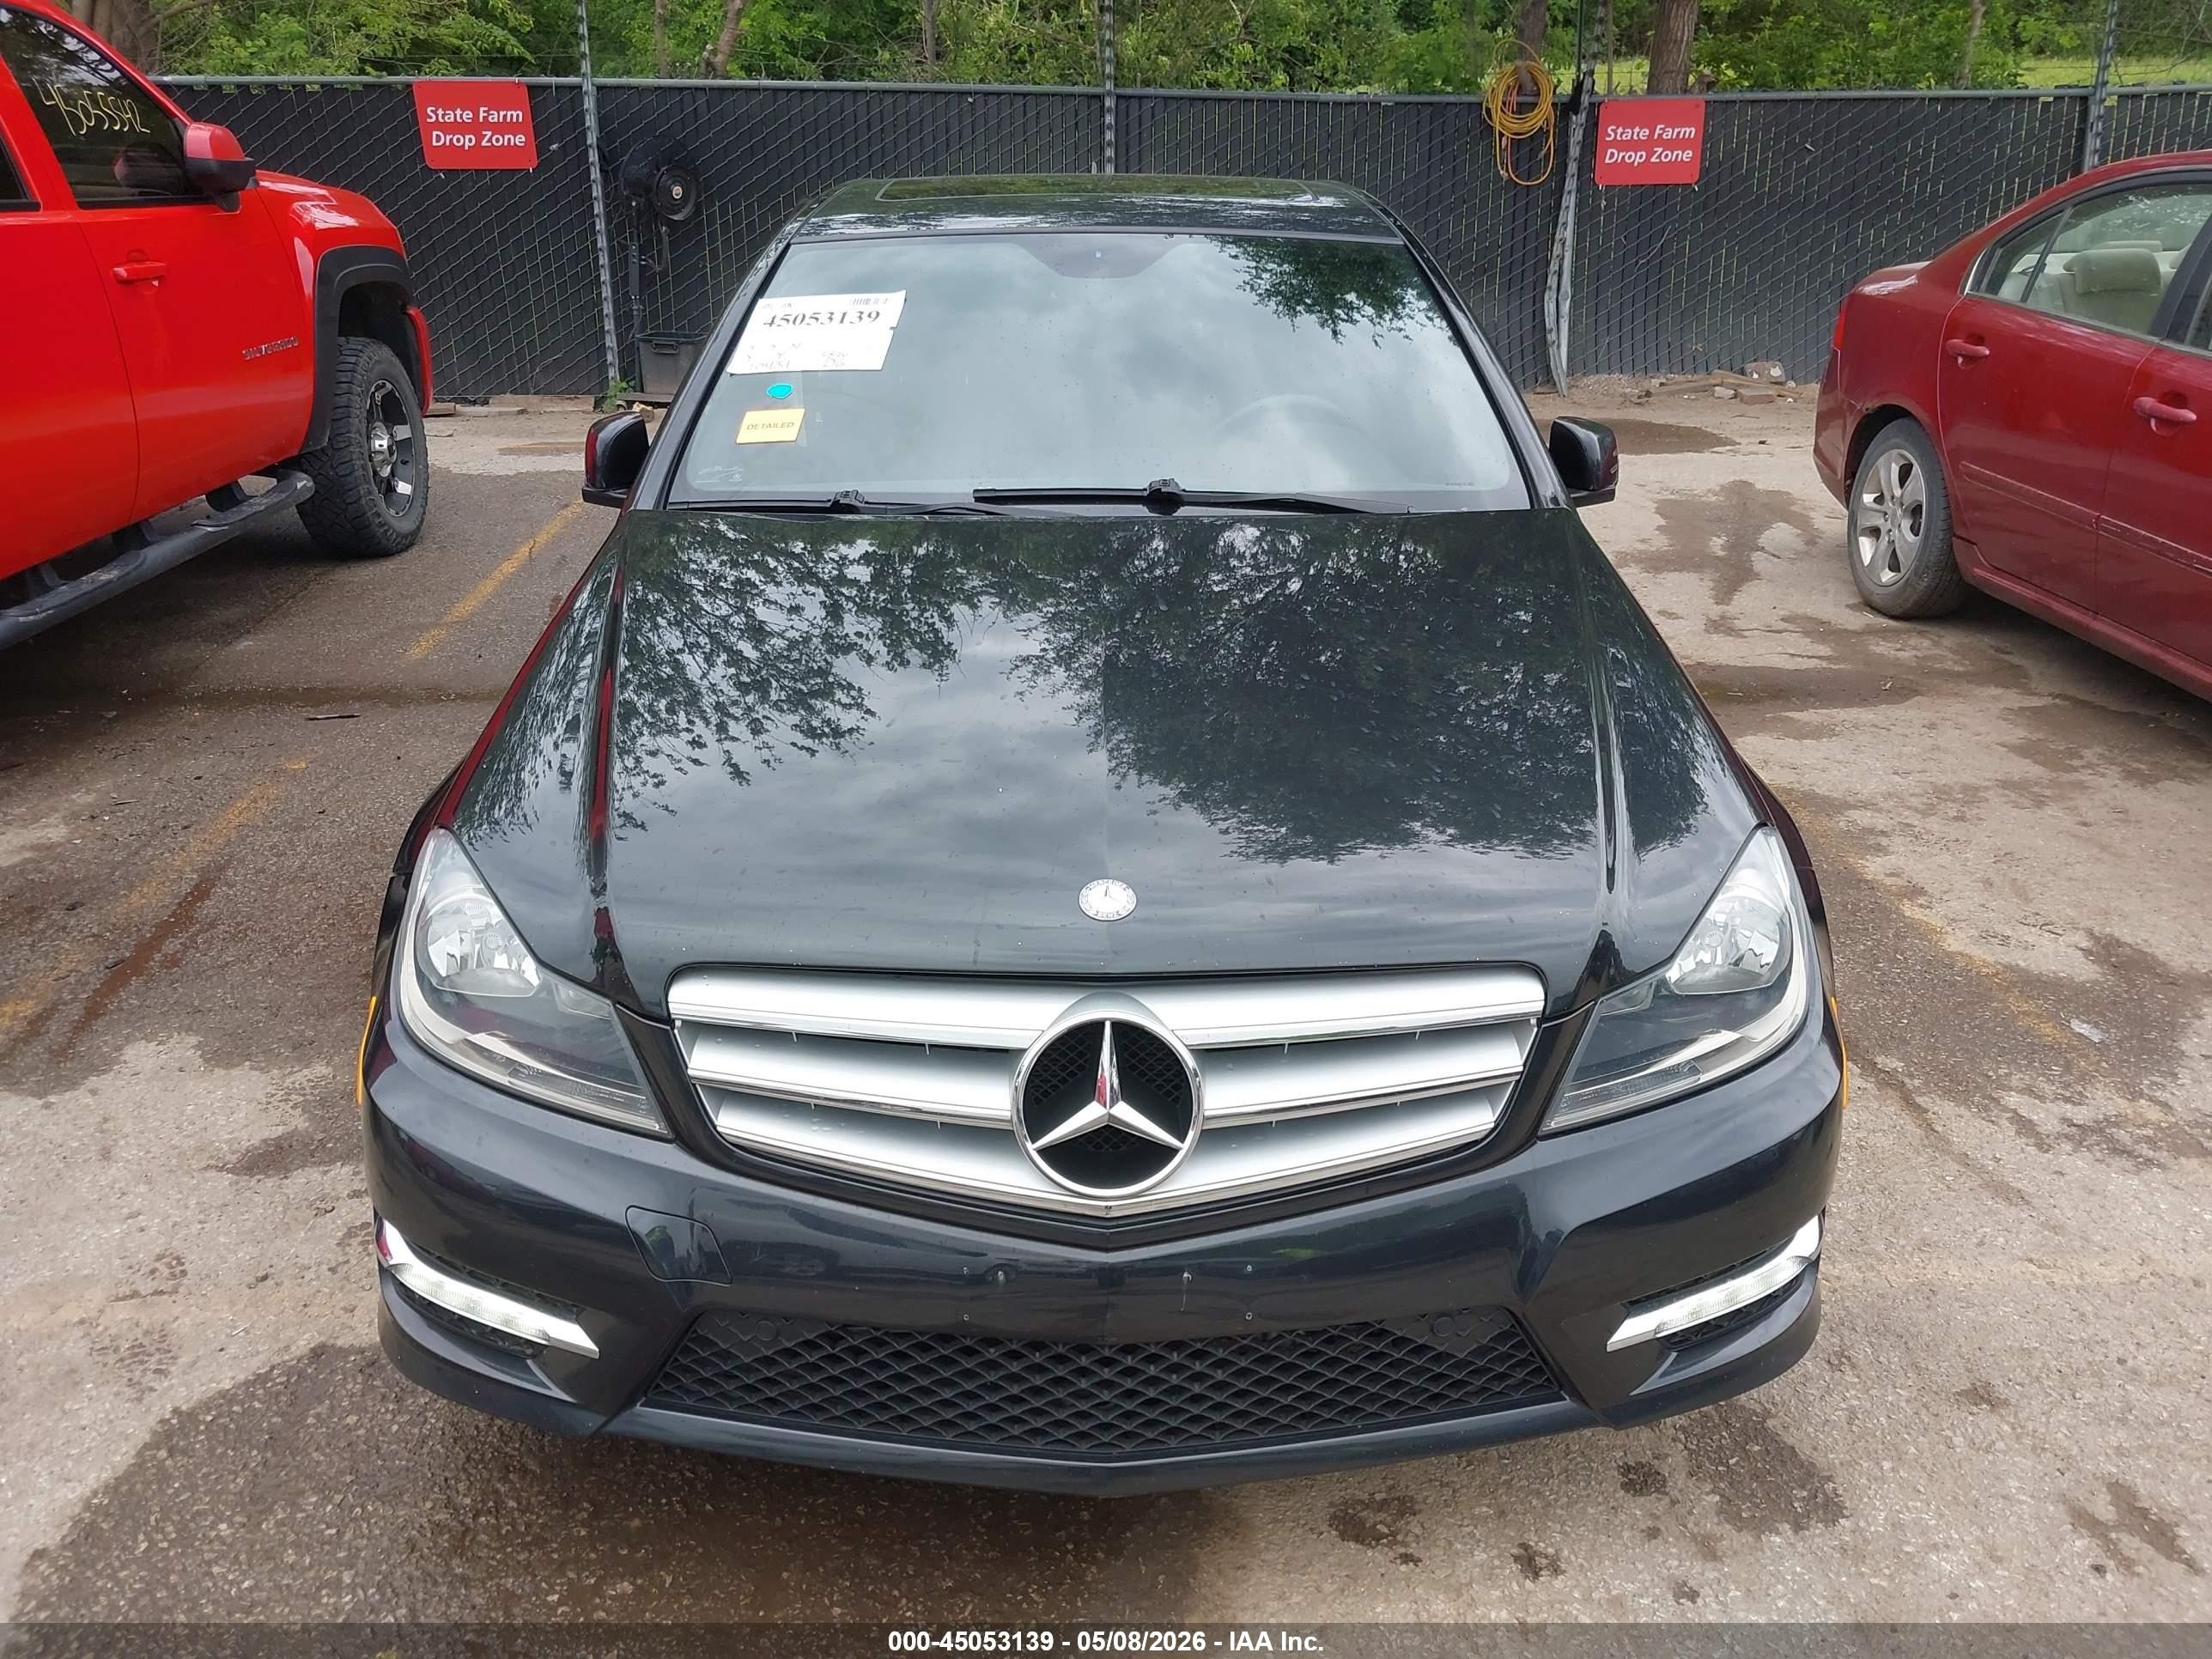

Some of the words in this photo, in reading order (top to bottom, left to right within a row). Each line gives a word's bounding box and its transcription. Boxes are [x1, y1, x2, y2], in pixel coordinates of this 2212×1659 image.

[426, 106, 473, 123] State
[479, 106, 523, 123] Farm
[432, 131, 476, 150] Drop
[481, 131, 526, 147] Zone
[1605, 125, 1650, 141] State
[1654, 125, 1696, 140] Farm
[1605, 149, 1647, 167] Drop
[1650, 148, 1693, 162] Zone
[763, 310, 881, 327] 45053139
[746, 421, 795, 431] DETAILED
